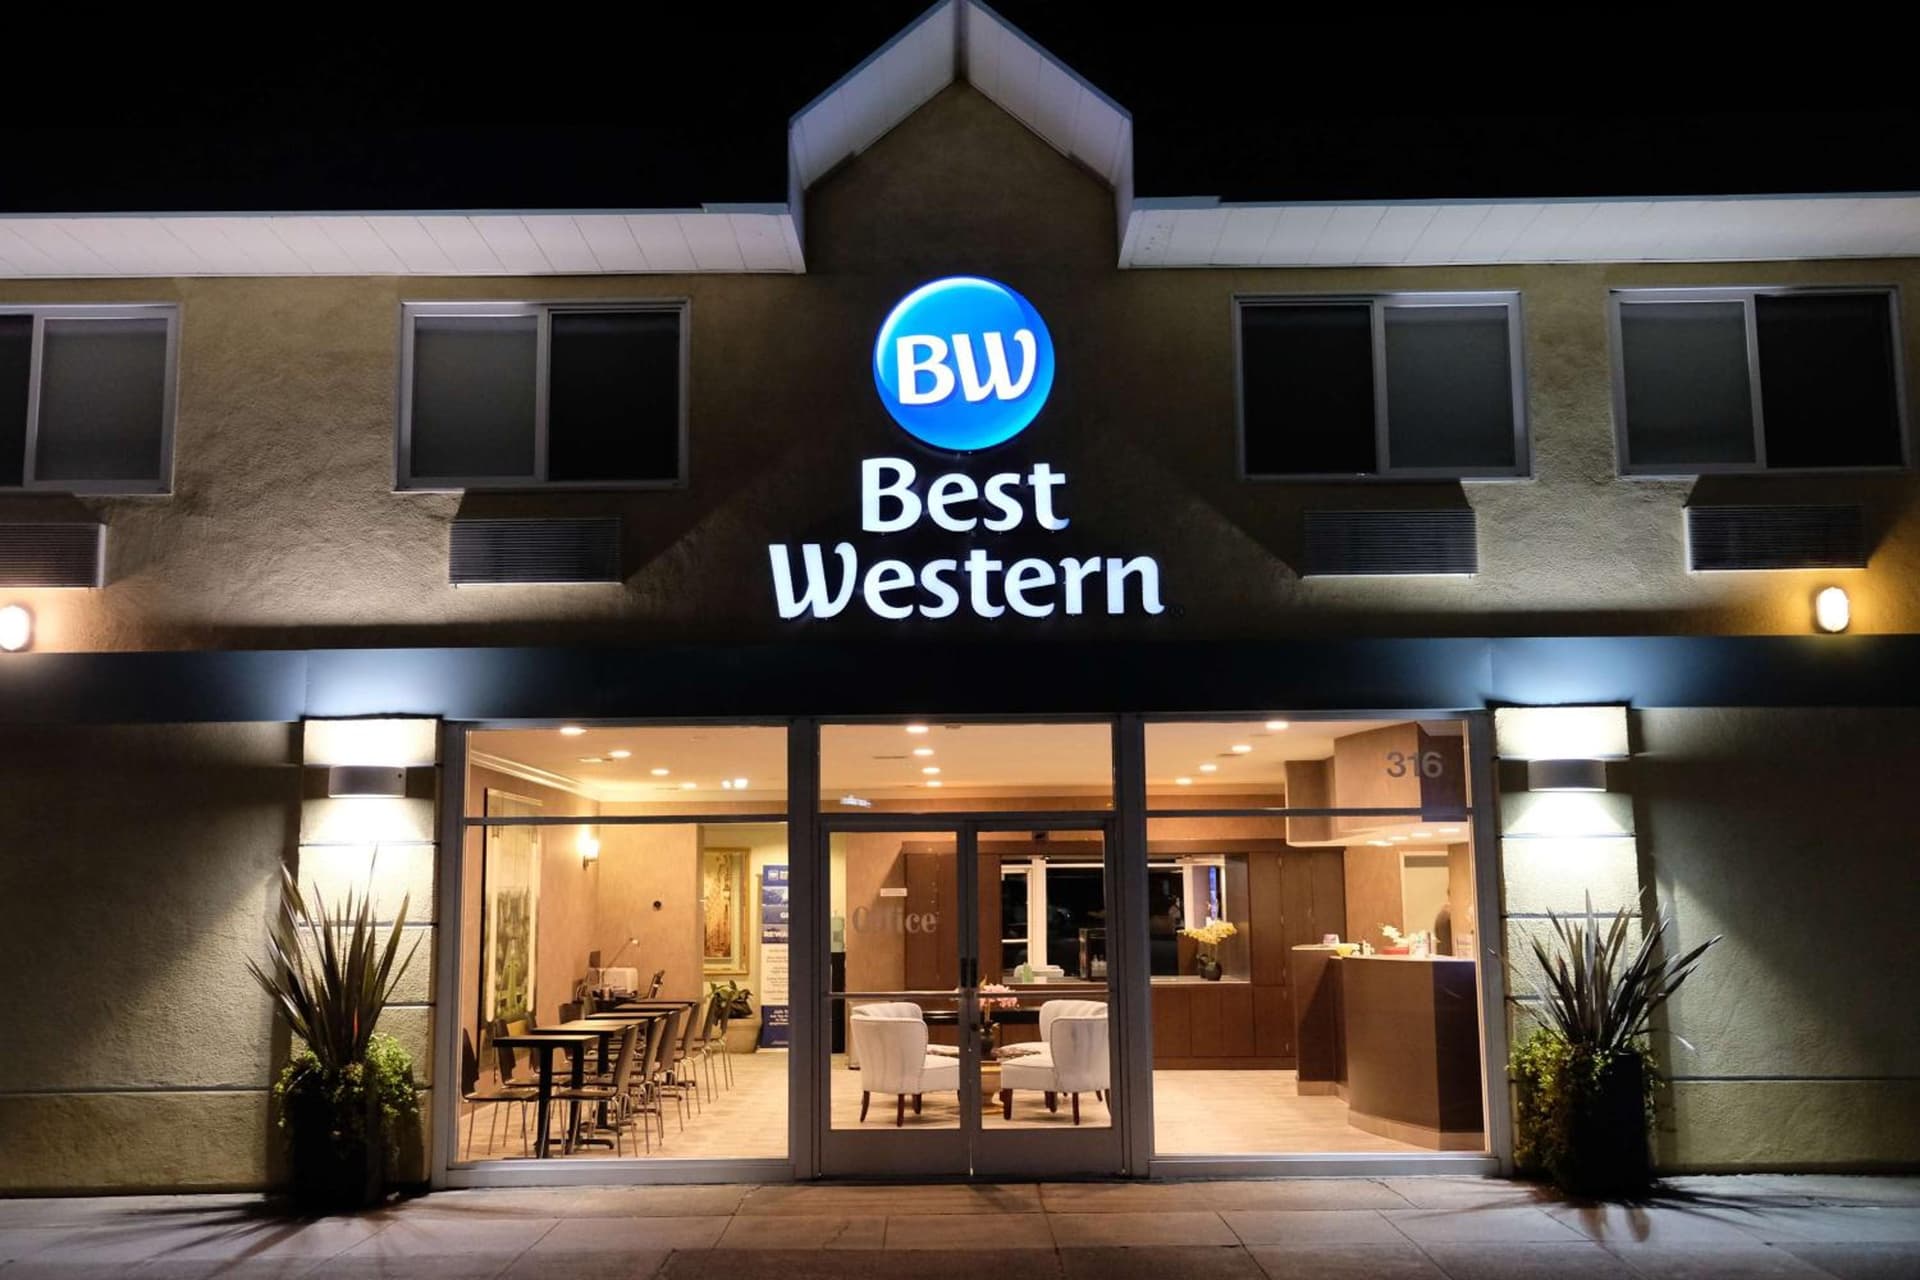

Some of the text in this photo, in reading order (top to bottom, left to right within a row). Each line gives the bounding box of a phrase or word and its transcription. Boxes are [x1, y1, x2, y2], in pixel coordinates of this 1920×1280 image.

[896, 329, 1037, 405] BW
[862, 457, 1069, 532] Best
[768, 542, 1165, 619] Western
[1386, 751, 1443, 778] 316
[852, 905, 937, 933] Ofice
